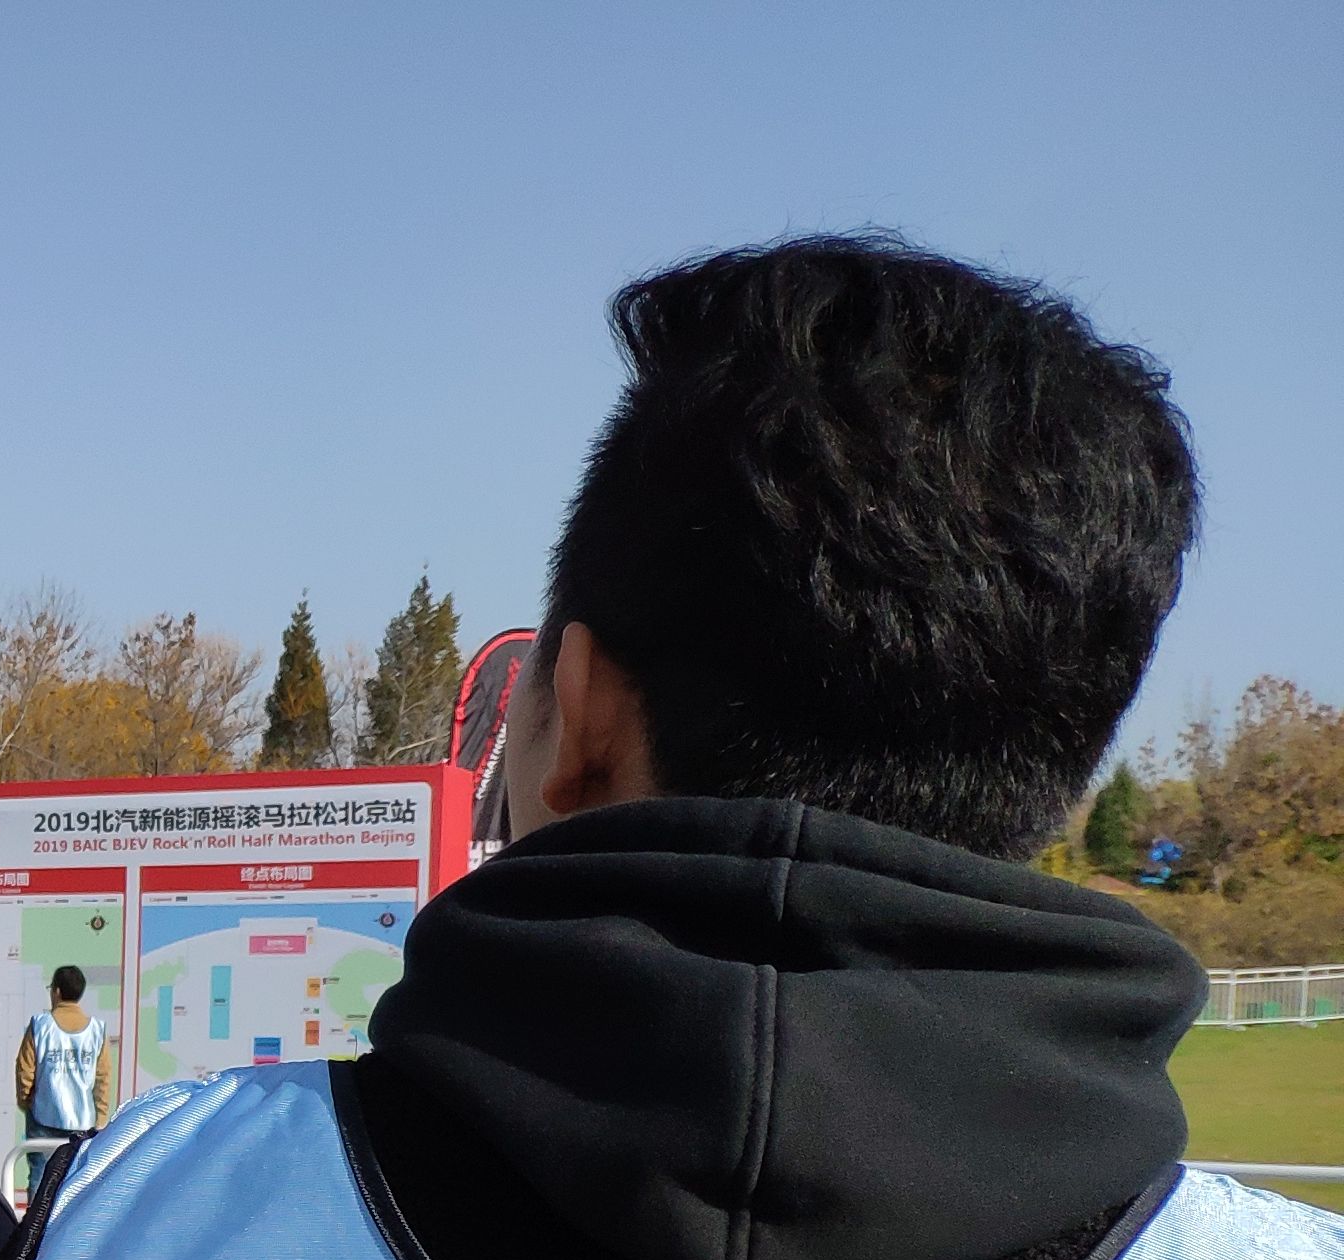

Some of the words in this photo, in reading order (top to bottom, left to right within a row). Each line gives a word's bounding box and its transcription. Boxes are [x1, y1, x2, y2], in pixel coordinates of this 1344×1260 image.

[33, 798, 417, 833] 2019北汽新能源摇滚马拉松北京站
[33, 840, 68, 853] 2019
[73, 838, 107, 852] BAIC
[113, 838, 147, 851] BJEV
[242, 833, 274, 847] Half
[279, 831, 355, 846] Marathon
[361, 829, 416, 847] Beijing
